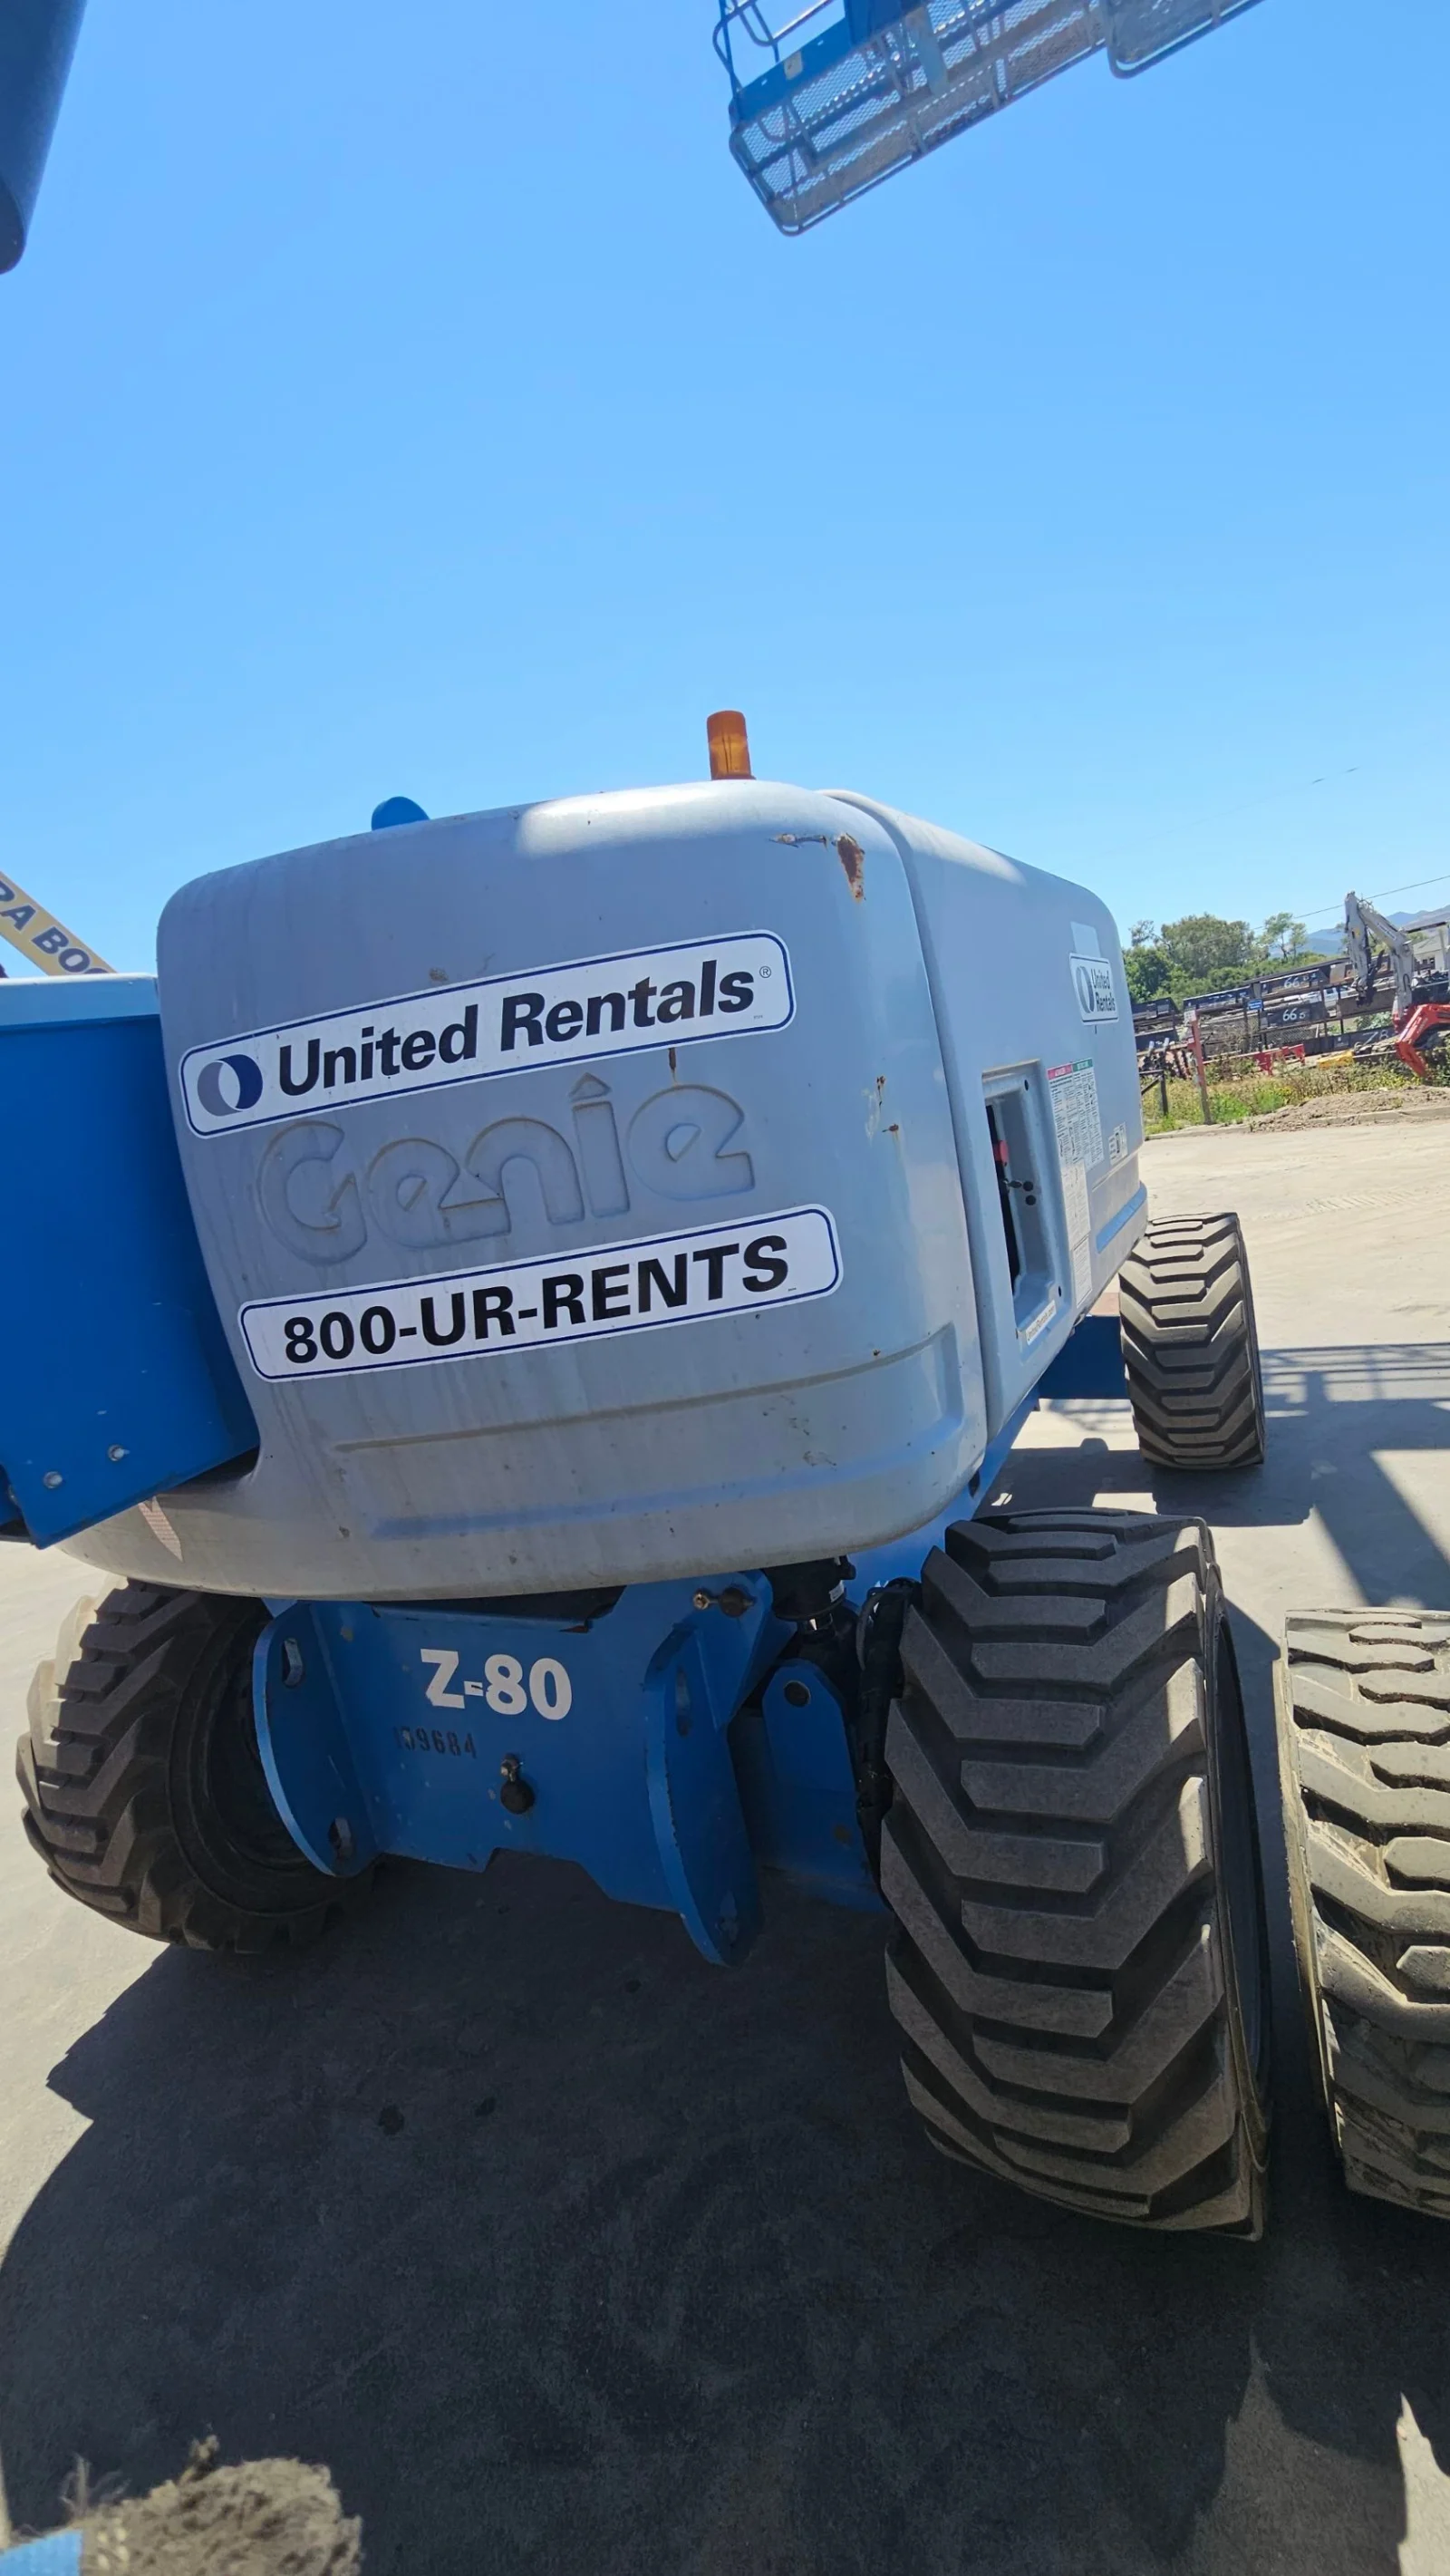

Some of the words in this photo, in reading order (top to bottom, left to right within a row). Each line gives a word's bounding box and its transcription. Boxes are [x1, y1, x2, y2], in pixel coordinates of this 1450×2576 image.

[31, 926, 109, 973] BO
[1090, 968, 1110, 990] United
[1095, 992, 1116, 1012] Rentals
[279, 1003, 478, 1096] United
[258, 1072, 755, 1264] Genie
[285, 1235, 788, 1364] 800-UR-RENTS
[420, 1648, 573, 1720] Z-80
